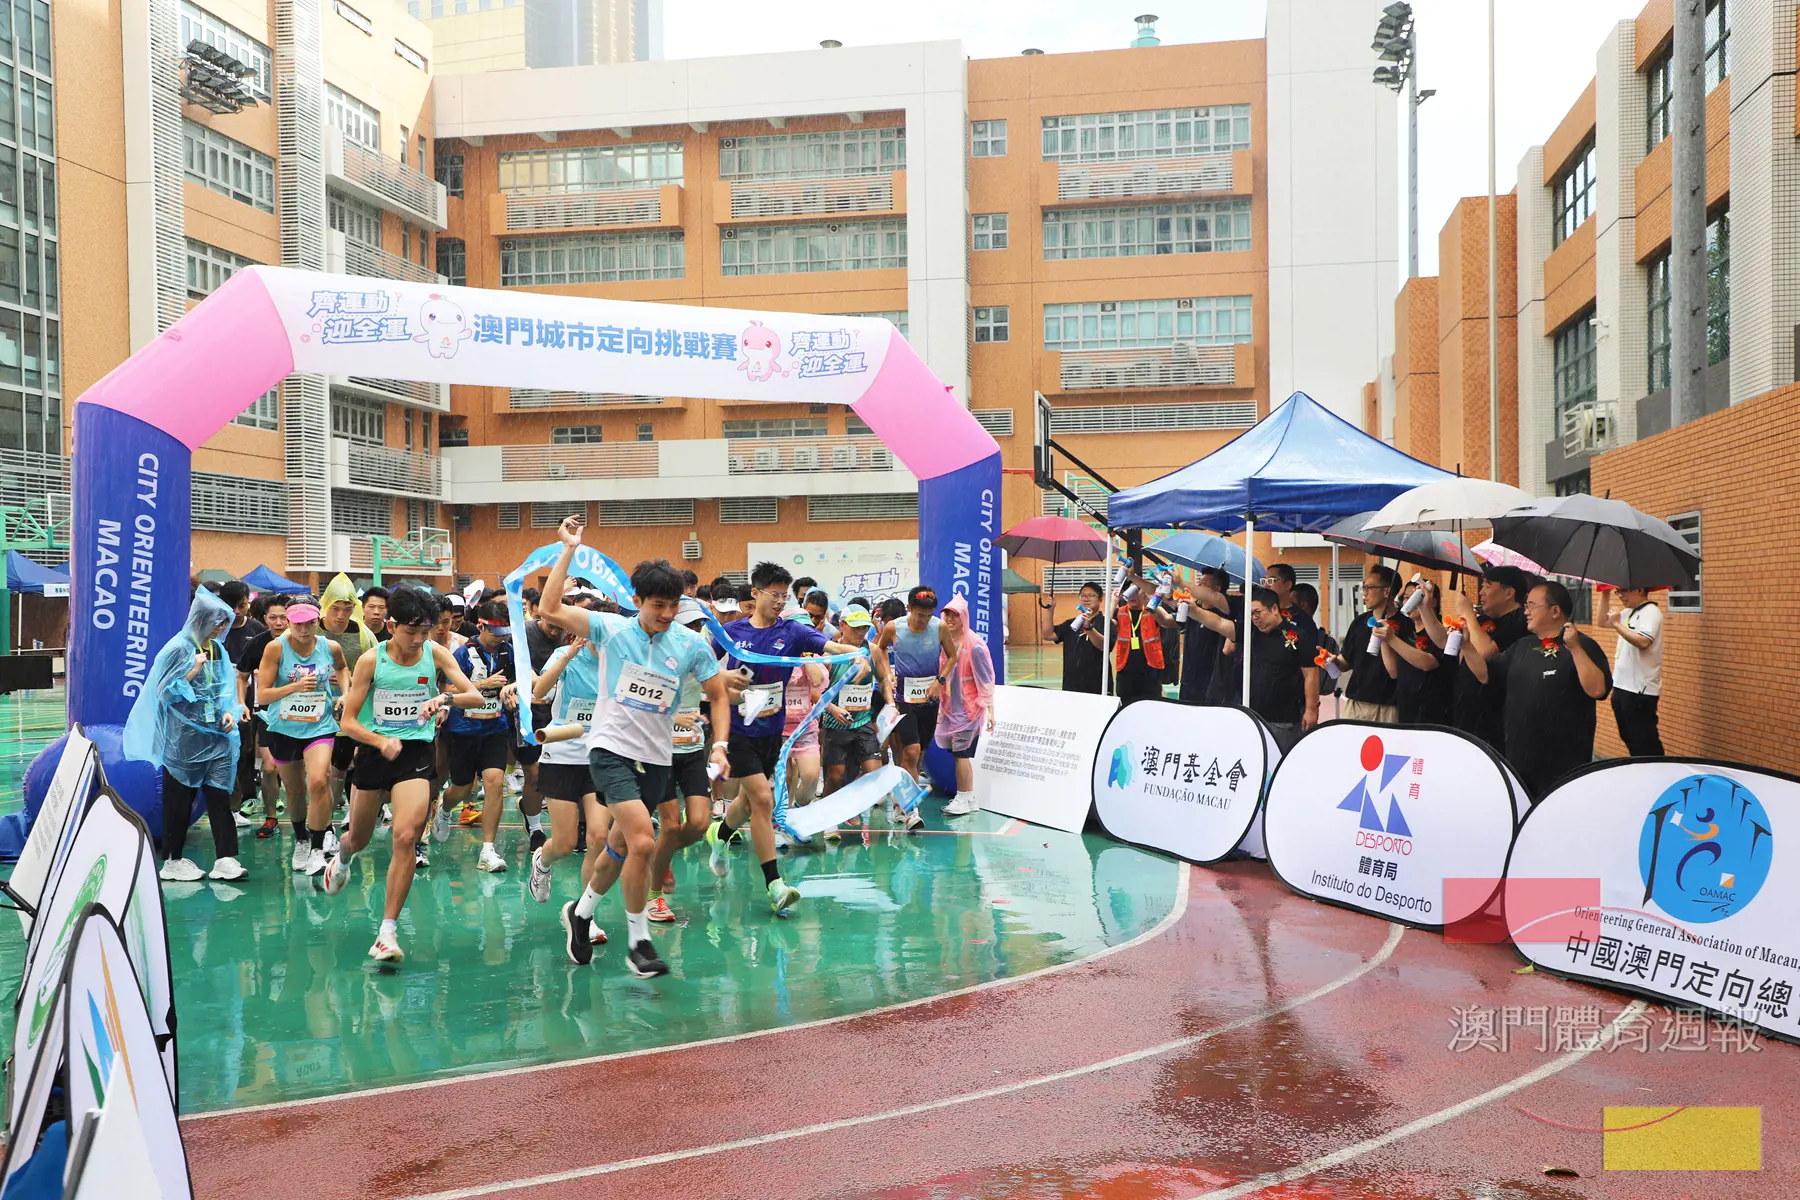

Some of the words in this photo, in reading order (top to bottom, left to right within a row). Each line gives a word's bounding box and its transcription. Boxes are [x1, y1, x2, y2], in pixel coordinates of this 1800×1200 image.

[306, 289, 390, 319] 齊運動
[321, 317, 412, 345] 迎全運
[473, 312, 739, 362] 澳門城市定向挑戰賽
[788, 328, 851, 357] 齊運動
[798, 351, 868, 379] 迎全運
[137, 452, 159, 509] CITY
[980, 489, 994, 533] CITY
[92, 518, 121, 630] MACAO
[952, 541, 972, 601] MAC
[976, 537, 992, 643] ORIENTEER
[123, 514, 156, 698] ORIENTEERING
[628, 682, 663, 700] B012
[786, 698, 802, 706] 014
[289, 704, 317, 713] A007
[384, 706, 418, 716] B012
[577, 713, 593, 722] B0
[1141, 745, 1248, 793] 澳門基金會
[1143, 782, 1195, 803] FUNDAÇÃO
[1196, 792, 1231, 811] MACAU
[1355, 830, 1413, 856] DESPORTO
[1358, 856, 1398, 881] 體育局
[1311, 870, 1354, 894] Instituto
[1356, 881, 1372, 899] do
[1375, 886, 1432, 914] Desporto
[1699, 886, 1736, 902] OAMAC
[1574, 905, 1633, 932] Orienteering
[1635, 918, 1676, 939] General
[1678, 927, 1742, 956] Association
[1745, 945, 1759, 959] of
[1759, 946, 1800, 973] Macau,
[1565, 930, 1800, 1019] 中國澳門定向總
